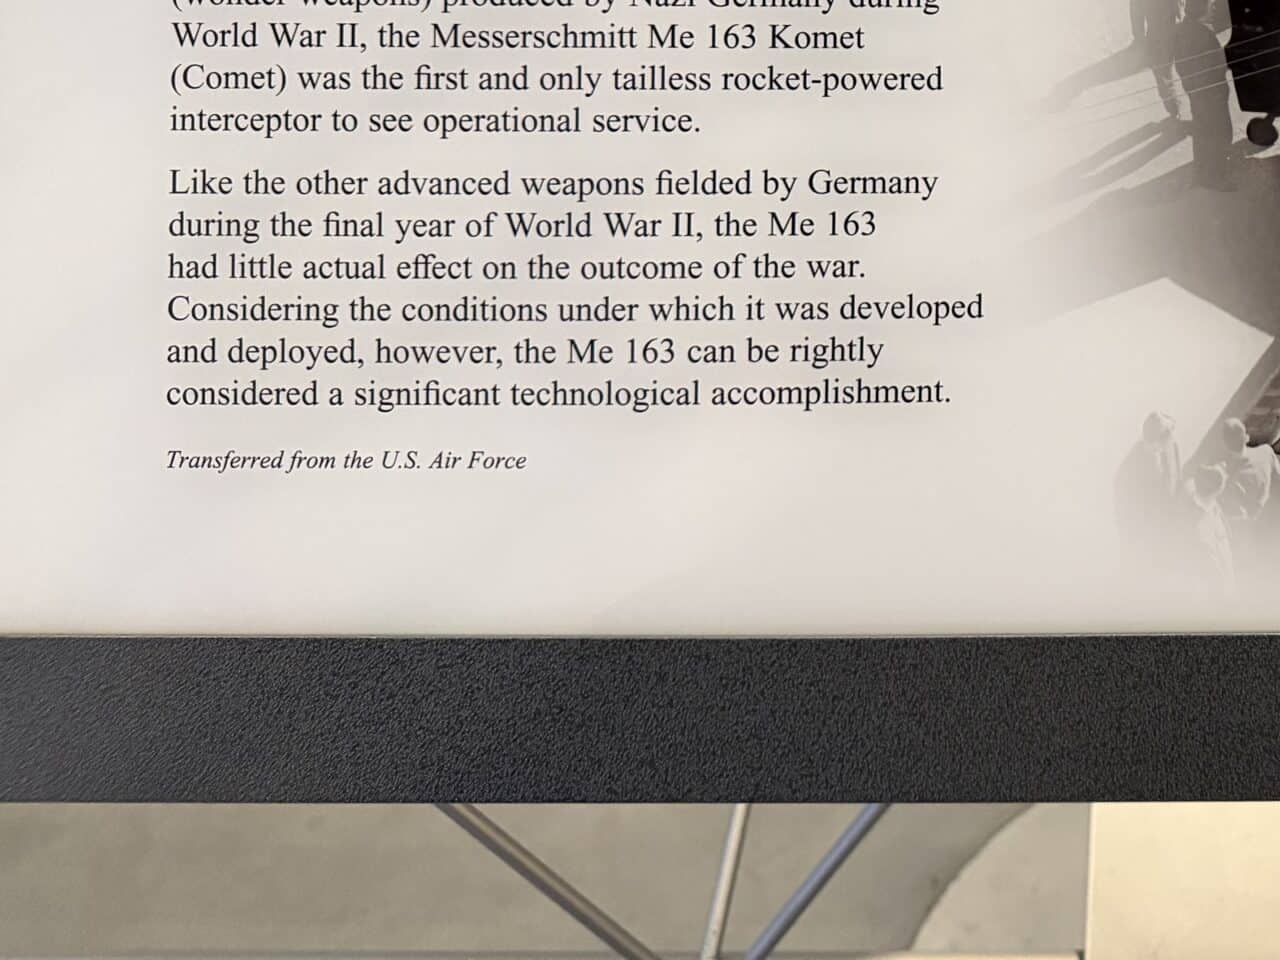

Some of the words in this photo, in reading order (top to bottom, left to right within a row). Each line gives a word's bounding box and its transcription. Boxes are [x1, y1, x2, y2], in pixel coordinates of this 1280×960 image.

[171, 22, 258, 47] World
[268, 23, 327, 48] War
[336, 23, 367, 53] II,
[377, 22, 420, 48] the
[430, 23, 638, 48] Messerschmitt
[647, 24, 694, 49] Me
[709, 24, 756, 49] 163
[768, 24, 865, 49] Komet
[171, 64, 286, 96] (Comet)
[296, 72, 351, 90] was
[361, 64, 404, 90] the
[414, 64, 469, 90] first
[478, 64, 530, 90] and
[540, 65, 602, 97] only
[612, 65, 711, 91] tailless
[721, 65, 944, 98] rocket-powered
[170, 105, 322, 139] interceptor
[331, 109, 358, 132] to
[369, 114, 413, 132] see
[423, 106, 581, 139] operational
[593, 106, 700, 133] service.
[169, 168, 232, 195] Like
[243, 169, 285, 195] the
[296, 169, 368, 195] other
[378, 169, 511, 196] advanced
[520, 177, 644, 203] weapons
[656, 169, 752, 195] fielded
[762, 169, 797, 202] by
[808, 169, 939, 201] Germany
[169, 211, 260, 244] during
[269, 211, 312, 237] the
[323, 211, 384, 237] final
[395, 219, 456, 244] year
[465, 211, 498, 237] of
[504, 211, 592, 238] World
[603, 212, 662, 237] War
[672, 212, 703, 243] II,
[714, 211, 757, 237] the
[768, 211, 815, 236] Me
[829, 211, 875, 236] 163
[168, 253, 219, 279] had
[229, 253, 292, 279] little
[303, 253, 386, 279] actual
[397, 253, 472, 280] effect
[482, 261, 518, 280] on
[527, 254, 570, 280] the
[581, 257, 703, 280] outcome
[713, 253, 747, 279] of
[752, 253, 796, 279] the
[806, 260, 864, 278] war.
[168, 295, 339, 328] Considering
[349, 296, 391, 322] the
[401, 296, 547, 322] conditions
[557, 296, 639, 322] under
[648, 295, 736, 322] which
[745, 295, 765, 320] it
[774, 302, 829, 320] was
[840, 293, 984, 326] developed
[167, 337, 218, 363] and
[228, 337, 364, 371] deployed,
[375, 338, 503, 370] however,
[514, 338, 556, 364] the
[567, 339, 613, 364] Me
[627, 337, 675, 364] 163
[687, 345, 736, 363] can
[746, 337, 779, 363] be
[790, 336, 884, 369] rightly
[166, 379, 319, 406] considered
[329, 388, 344, 406] a
[355, 380, 501, 413] significant
[510, 379, 700, 413] technological
[712, 378, 950, 412] accomplishment.
[167, 450, 285, 474] Transferred
[285, 450, 336, 474] from
[344, 450, 373, 469] the
[382, 451, 420, 469] U.S.
[428, 451, 462, 469] Air
[467, 451, 527, 469] Force
